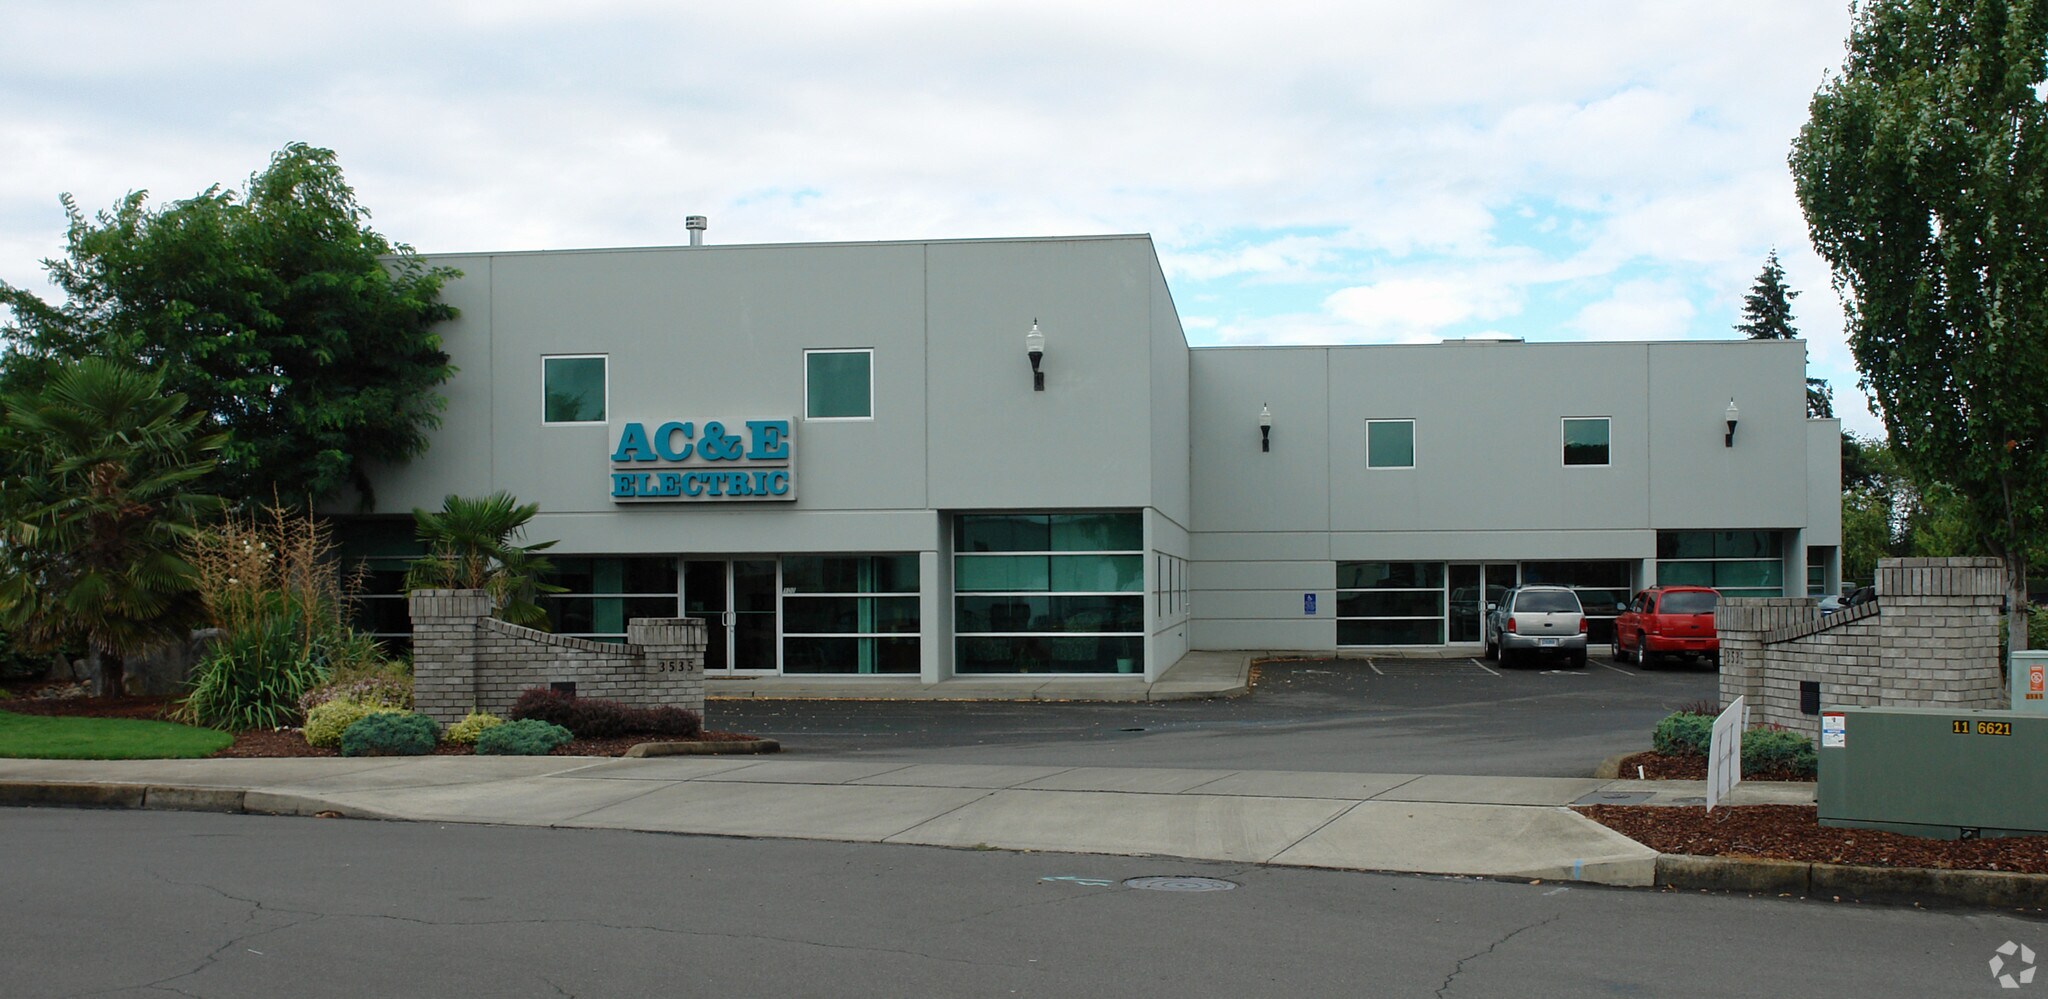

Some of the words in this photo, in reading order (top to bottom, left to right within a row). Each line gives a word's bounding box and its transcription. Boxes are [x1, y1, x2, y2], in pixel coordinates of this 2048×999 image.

[611, 420, 789, 462] AC&E
[611, 471, 789, 497] ELECTRIC
[659, 661, 694, 672] 3535
[1953, 721, 1969, 733] 11
[1978, 721, 2011, 735] 6621
